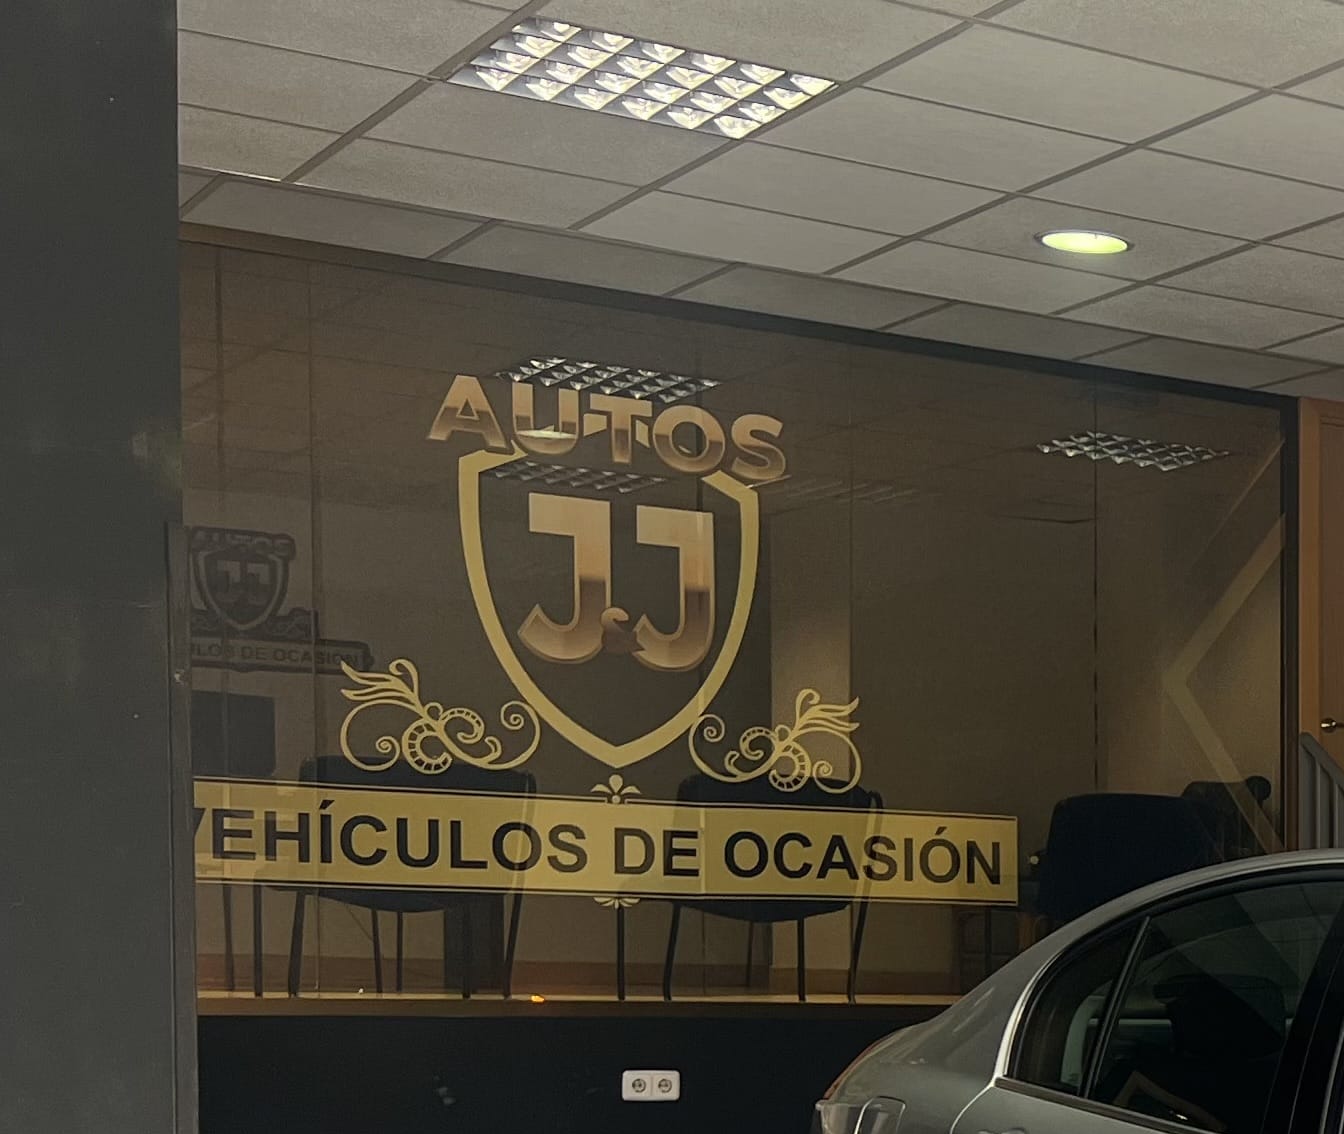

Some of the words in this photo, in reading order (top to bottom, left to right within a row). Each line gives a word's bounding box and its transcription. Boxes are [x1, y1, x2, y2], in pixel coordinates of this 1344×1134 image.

[425, 373, 787, 481] AUTOS
[613, 826, 700, 878] DE
[724, 826, 1001, 885] OCASIÓN
